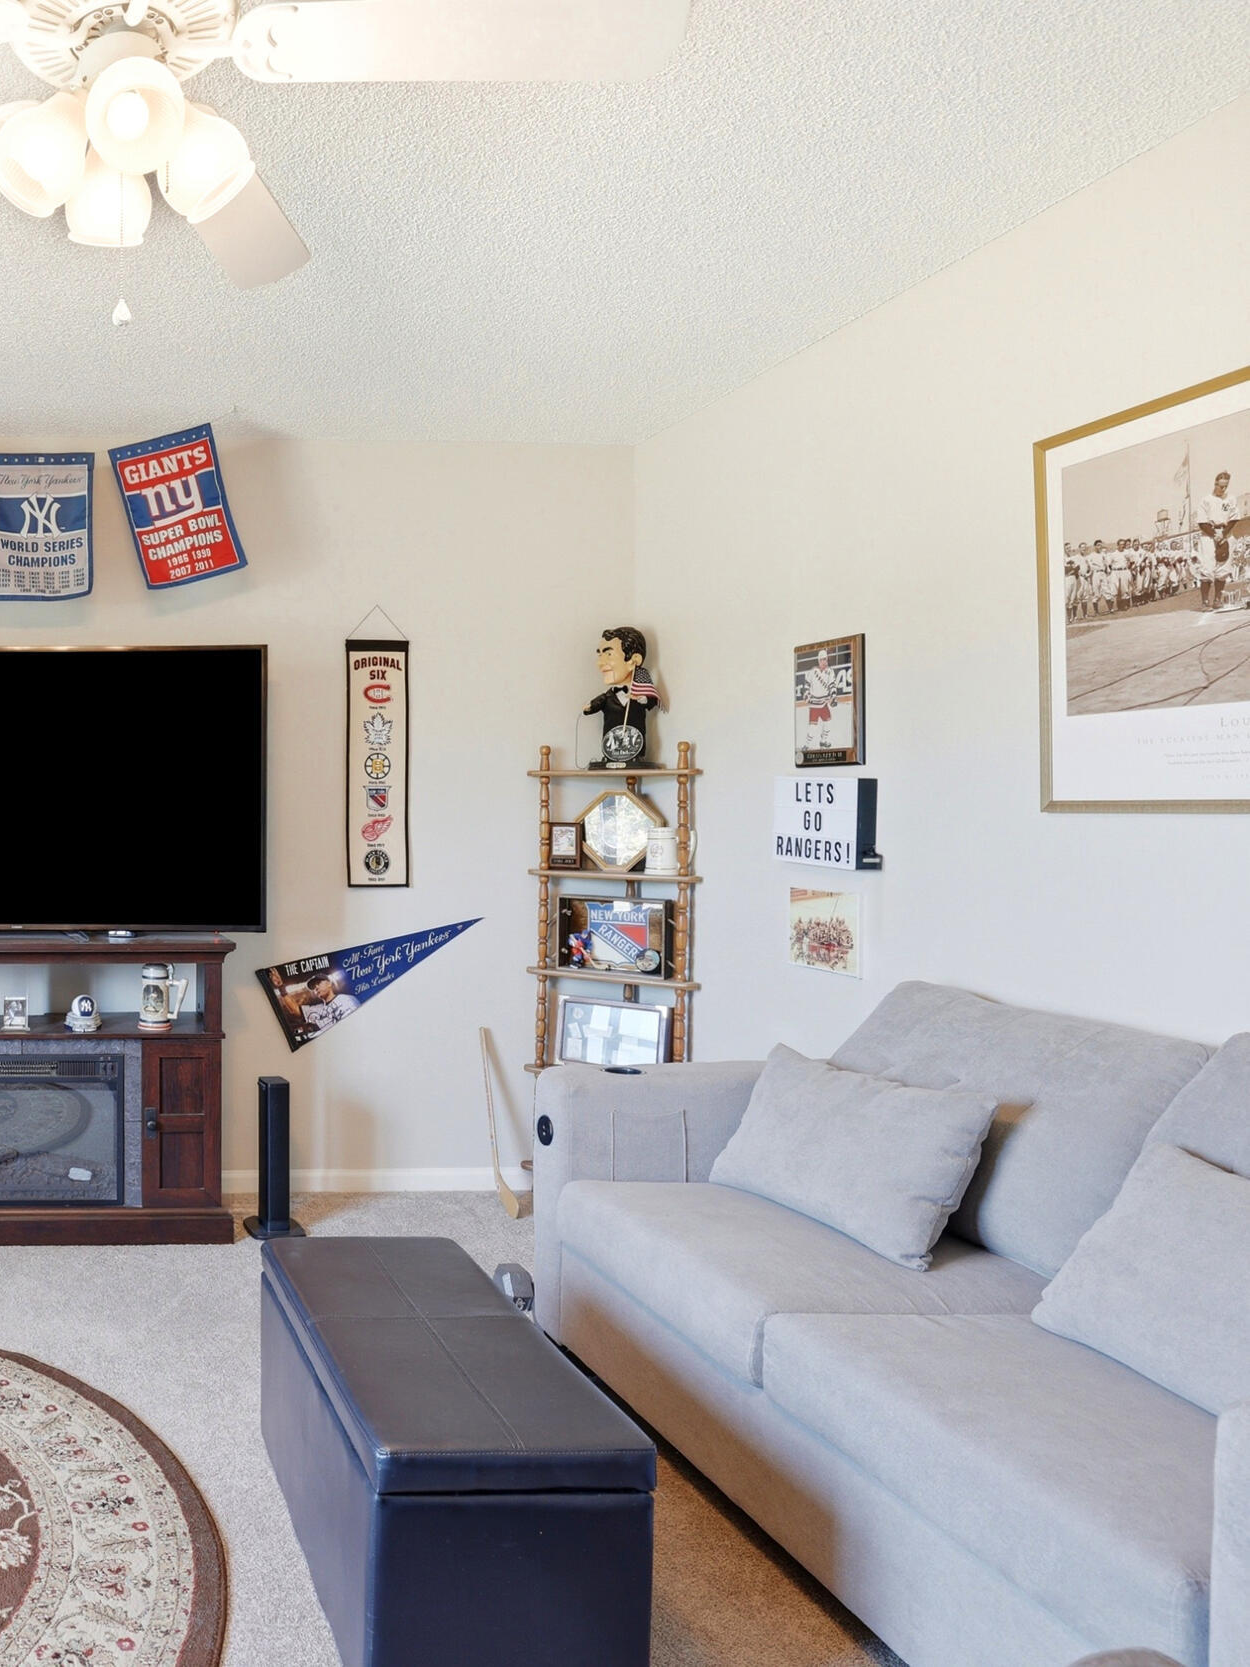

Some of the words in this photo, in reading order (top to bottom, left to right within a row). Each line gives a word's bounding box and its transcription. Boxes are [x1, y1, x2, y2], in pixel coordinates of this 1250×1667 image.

[124, 446, 207, 484] GIANTS
[142, 524, 184, 546] SUPER
[188, 514, 222, 531] BOWL
[0, 538, 39, 552] WORLD
[44, 537, 84, 552] SERIES
[148, 530, 223, 560] CHAMPIONS
[8, 554, 76, 568] CHAMPIONS
[170, 564, 191, 579] 2007
[194, 560, 214, 572] 2011
[354, 656, 402, 671] ORIGINAL
[370, 670, 387, 680] SIX
[796, 782, 834, 804] LETS
[804, 810, 822, 832] GO
[776, 836, 850, 864] RANGERS!
[590, 909, 612, 921] NEW
[616, 910, 646, 922] YORK
[285, 963, 299, 976] THE
[300, 956, 330, 973] CAPTAIN
[346, 963, 374, 980] New
[373, 946, 402, 975] York
